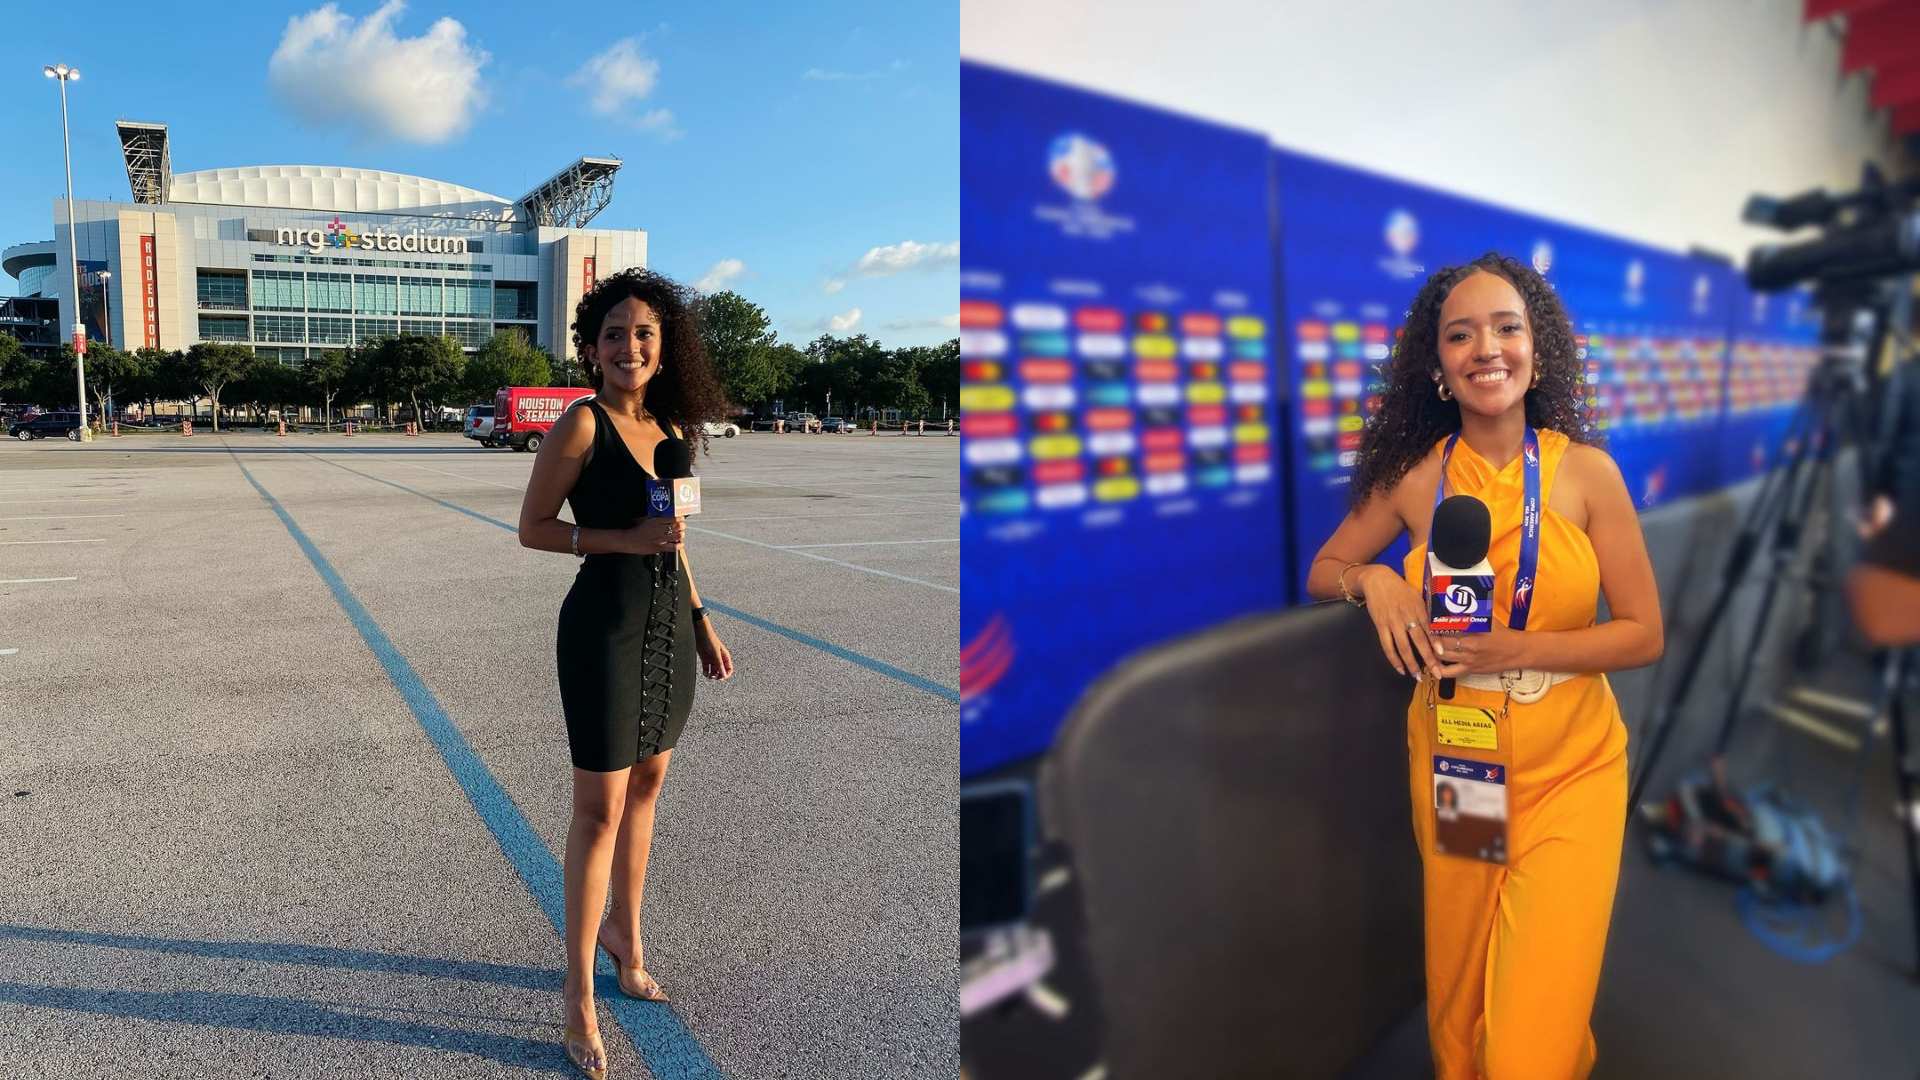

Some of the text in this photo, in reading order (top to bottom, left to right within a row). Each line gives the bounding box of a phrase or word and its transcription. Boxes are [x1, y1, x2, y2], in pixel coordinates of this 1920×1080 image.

[277, 226, 468, 254] nrg stadium
[518, 398, 564, 410] HOUSTON
